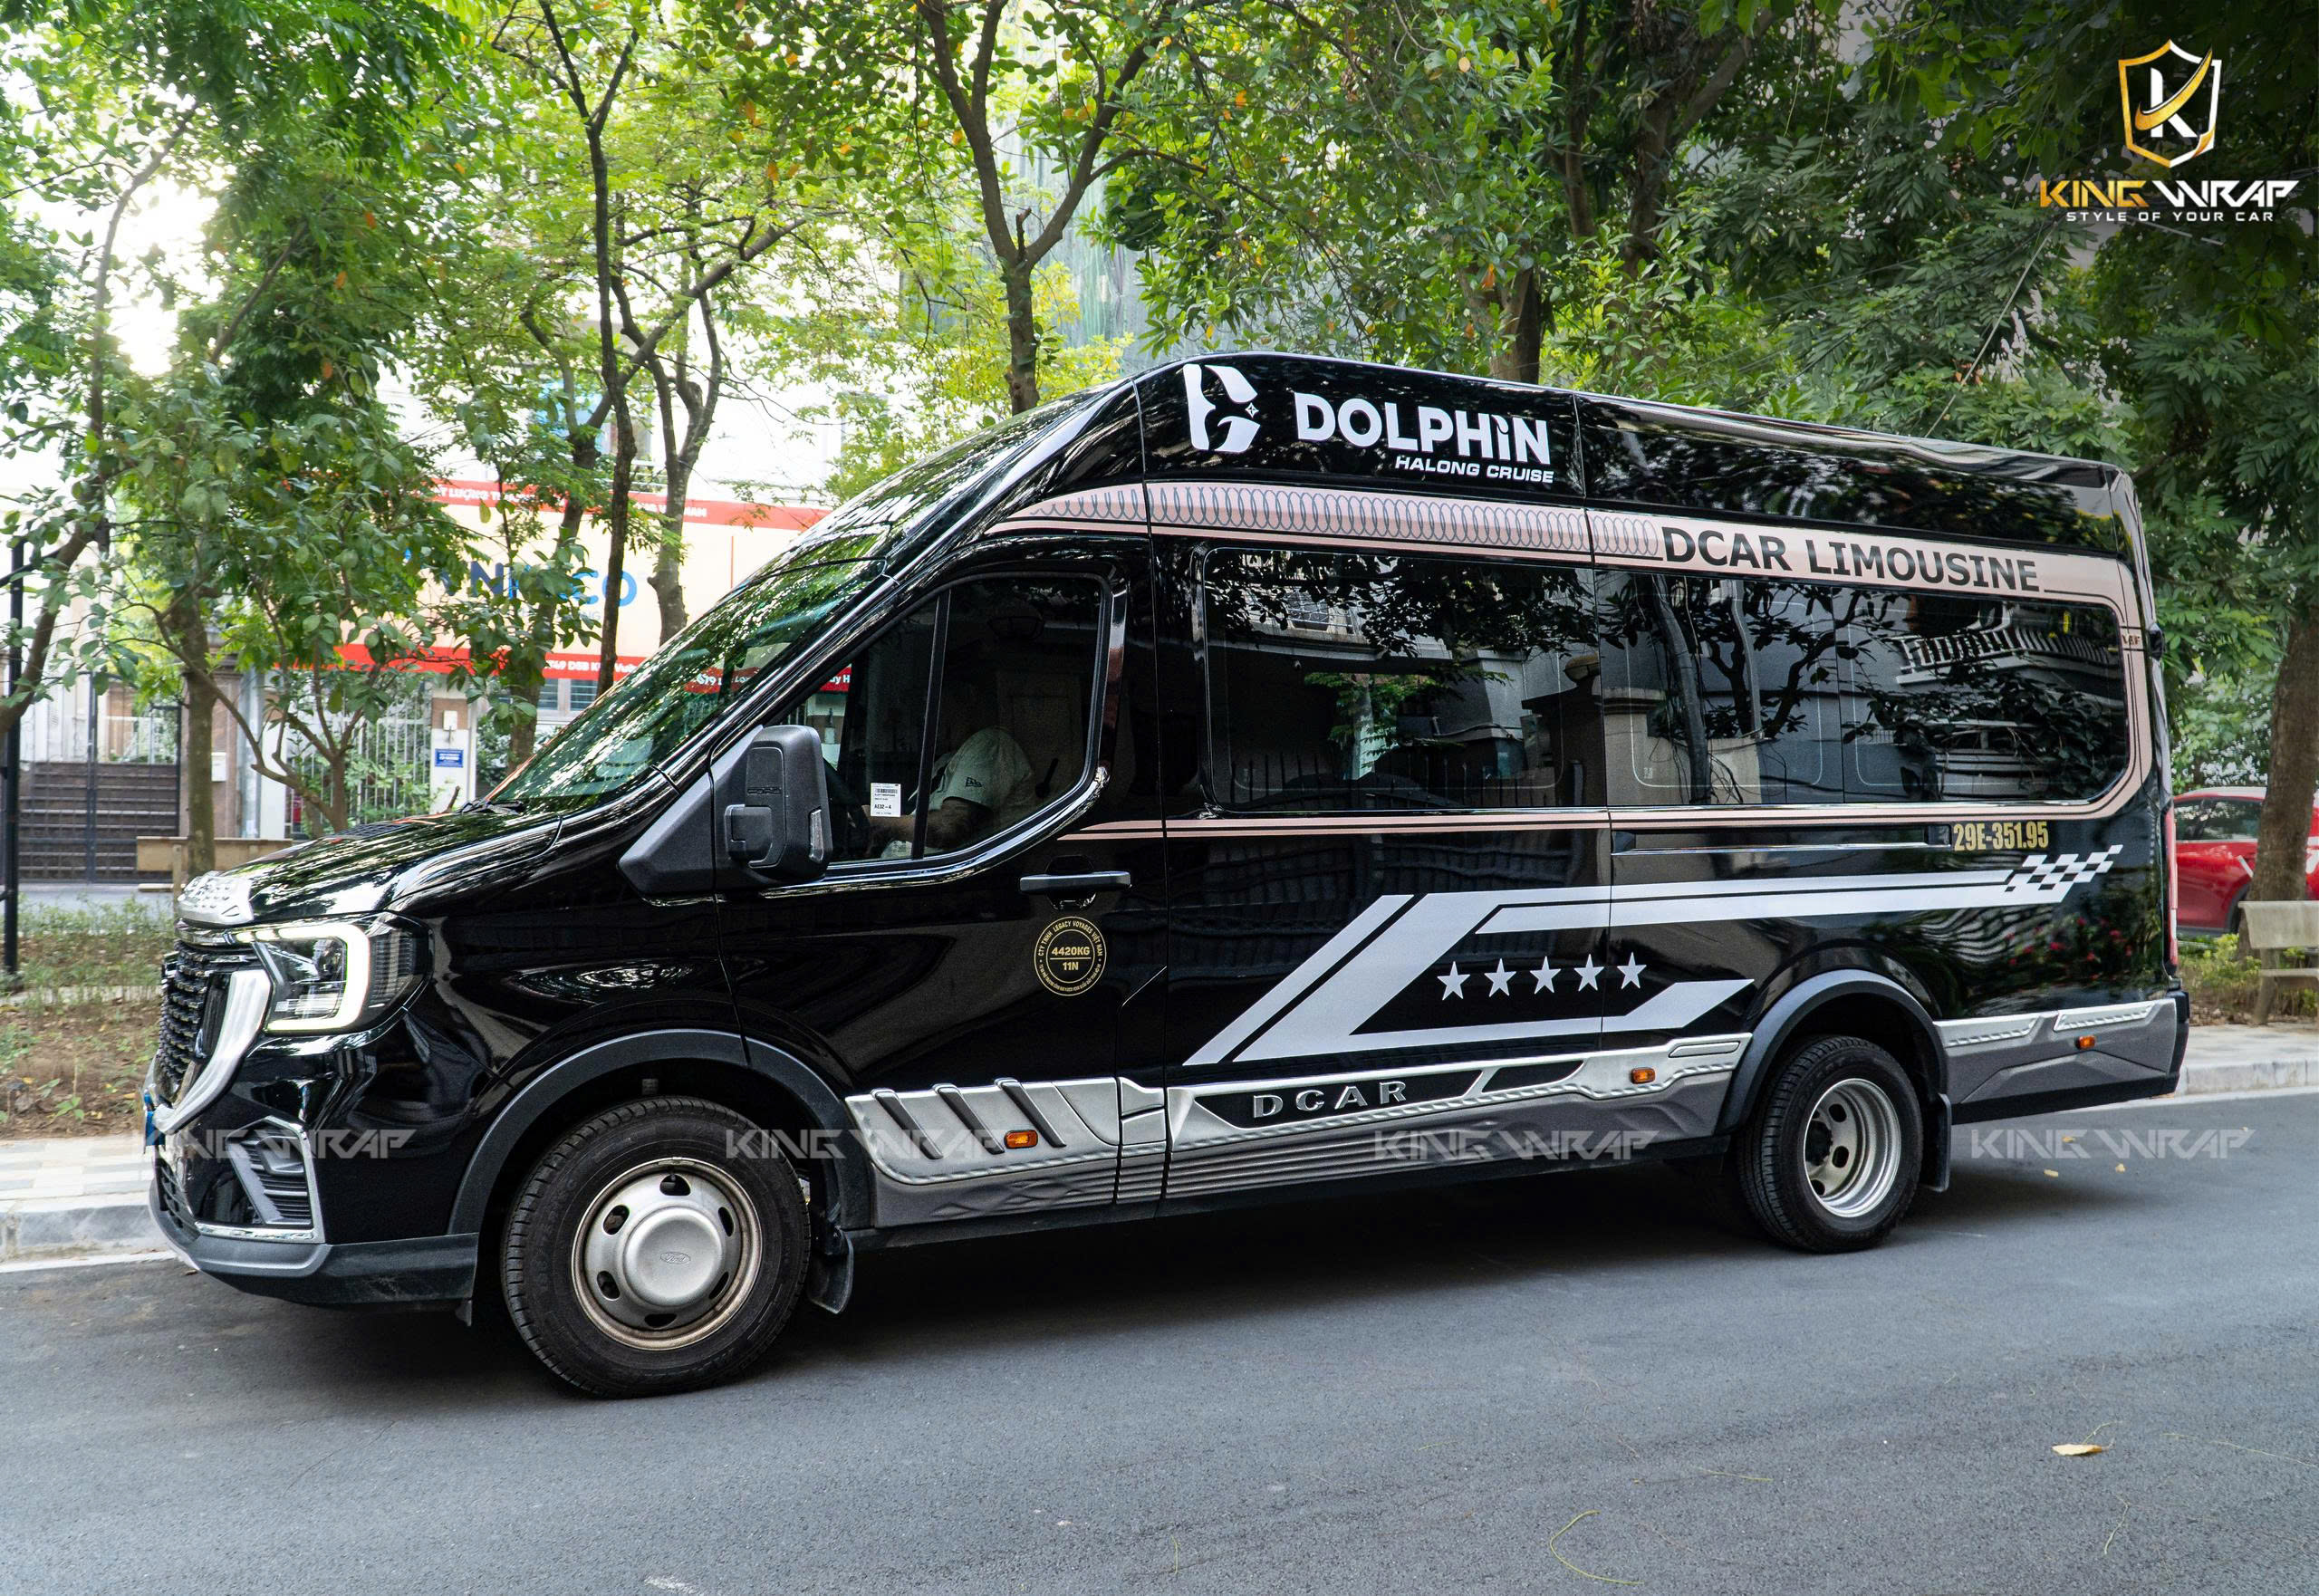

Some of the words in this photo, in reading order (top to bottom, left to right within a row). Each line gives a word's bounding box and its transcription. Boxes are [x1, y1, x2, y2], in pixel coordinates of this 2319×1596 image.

[1294, 391, 1552, 466] DOLPHIN
[1395, 455, 1481, 477] HALONG
[1486, 464, 1554, 484] CRUISE
[1661, 526, 1793, 572] DCAR
[1805, 539, 2041, 592] LIMOUSINE
[1953, 821, 2049, 851] 29E-351.95
[1052, 947, 1091, 956] 4420KG
[1063, 961, 1079, 971] 11N
[1253, 1080, 1408, 1119] DCAR
